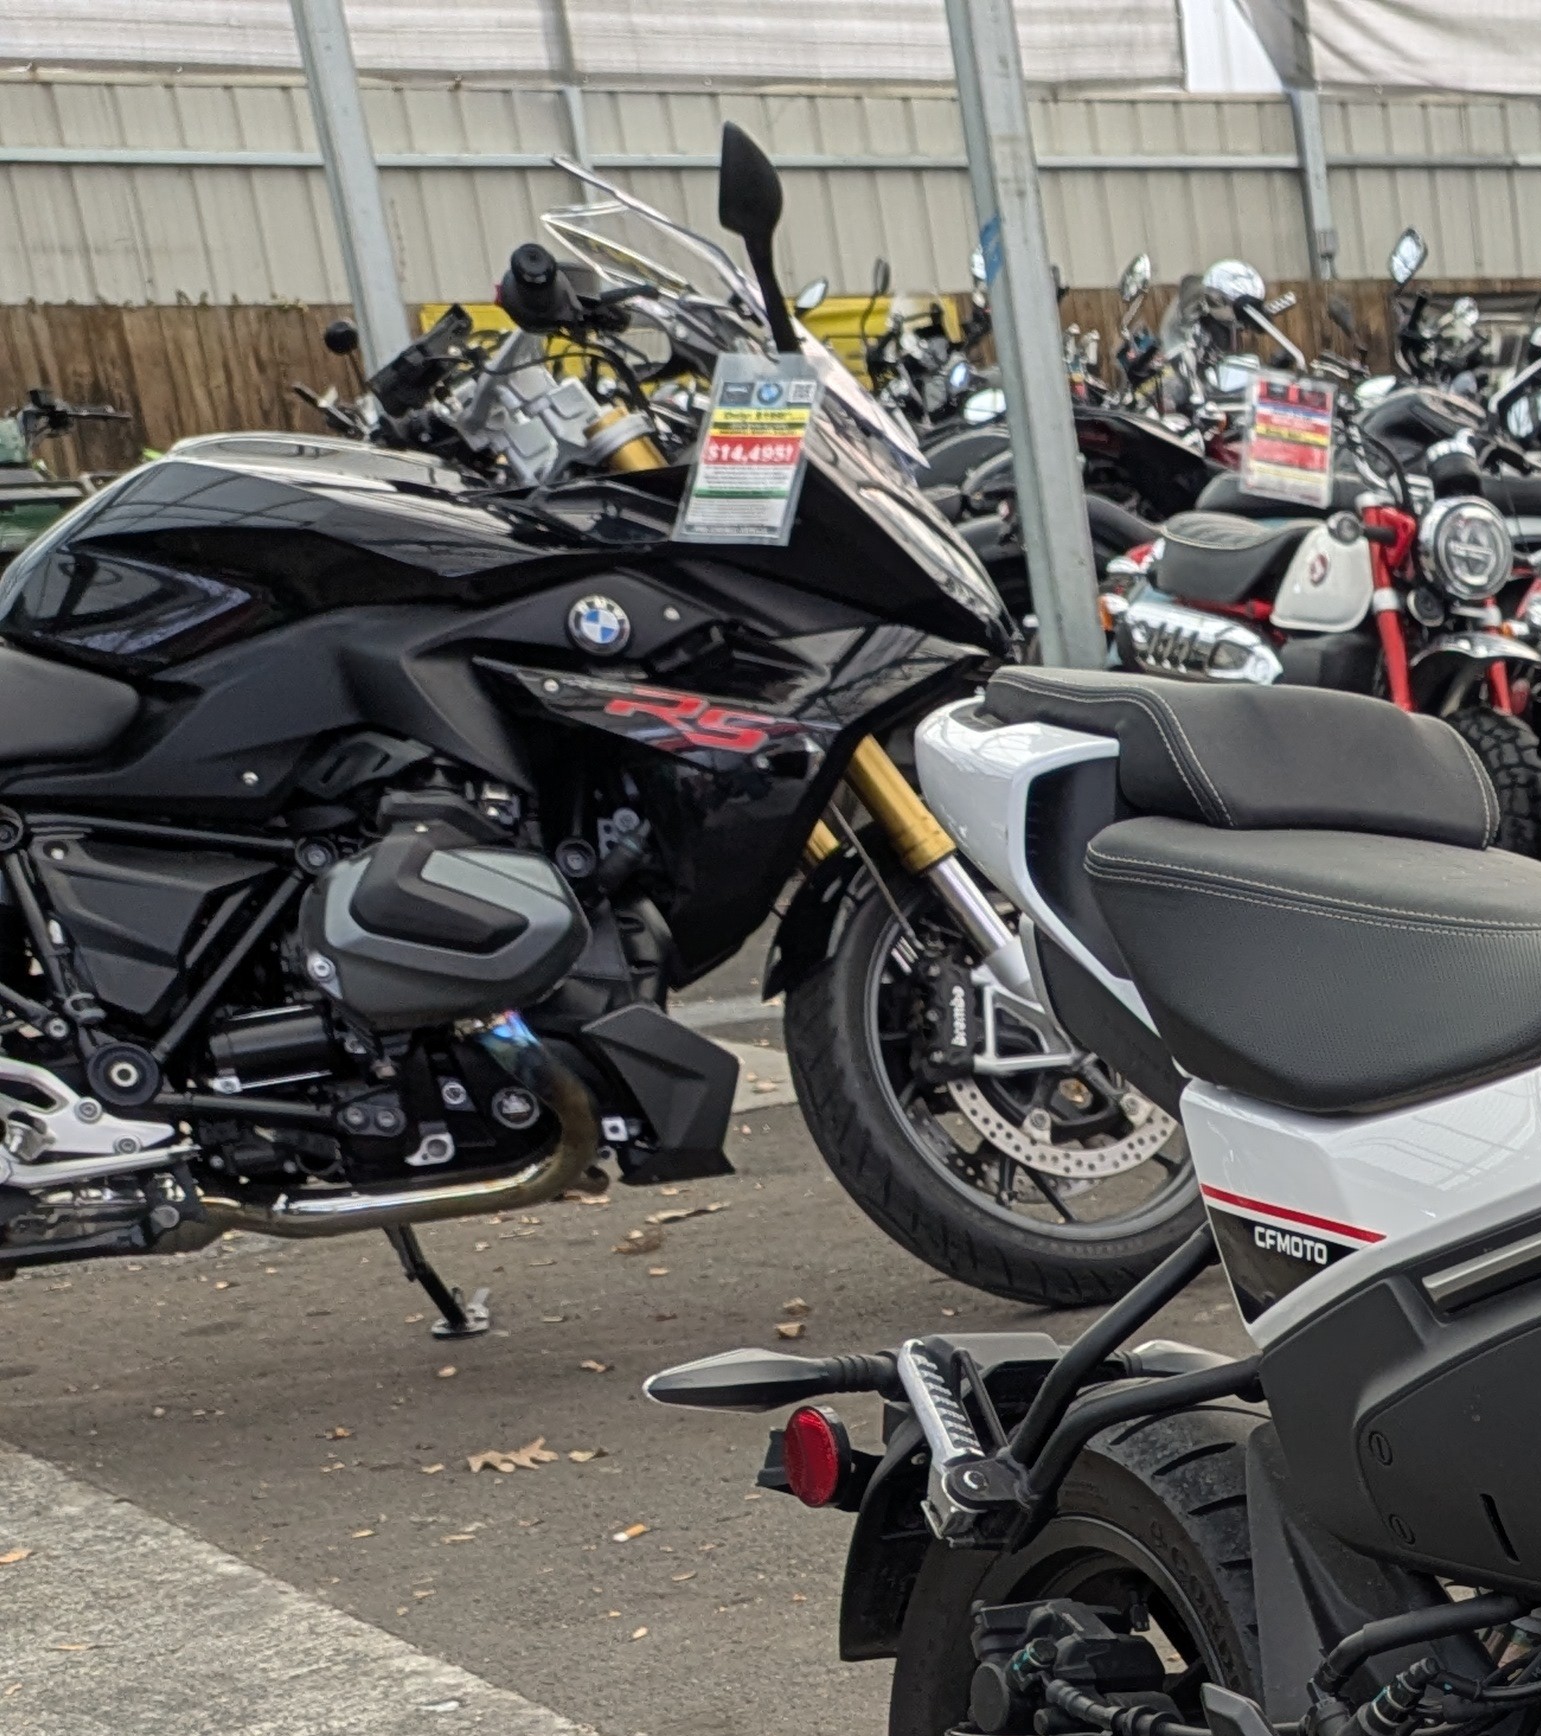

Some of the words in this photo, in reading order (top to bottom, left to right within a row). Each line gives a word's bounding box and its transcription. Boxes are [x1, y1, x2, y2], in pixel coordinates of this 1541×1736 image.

[604, 685, 770, 753] RS
[949, 985, 967, 1046] brembo
[1254, 1226, 1328, 1265] CFMOTO
